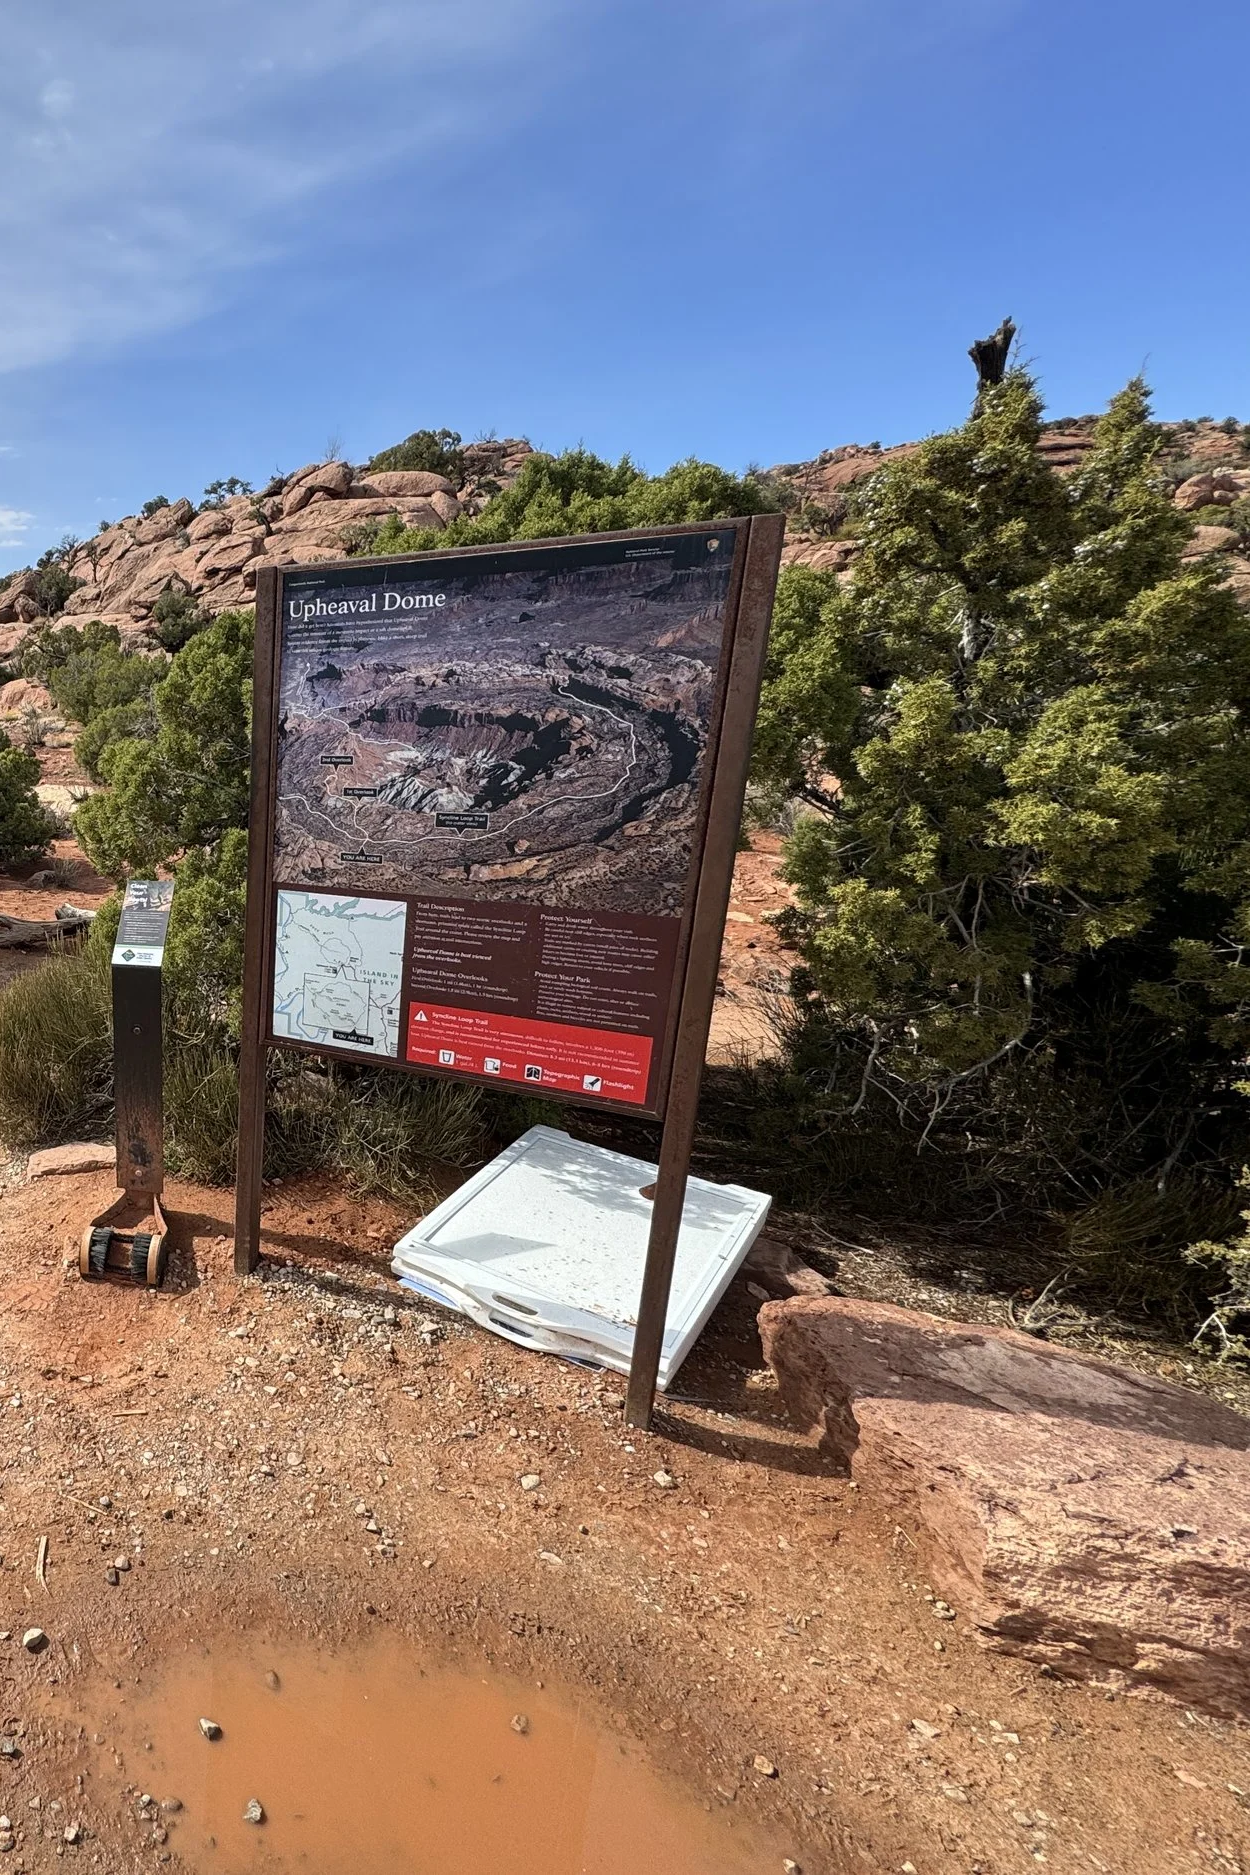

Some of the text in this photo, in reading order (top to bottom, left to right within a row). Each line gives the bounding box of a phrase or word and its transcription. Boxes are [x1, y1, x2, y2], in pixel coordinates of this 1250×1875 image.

[289, 592, 446, 622] Upheaval Dome
[431, 904, 464, 912] Description
[360, 970, 387, 978] ISLAND
[412, 967, 438, 975] Upheaval
[458, 972, 488, 982] Overlooks
[432, 1012, 456, 1020] Syncline
[543, 1069, 580, 1081] Topographic
[603, 1080, 634, 1090] Flashlight
